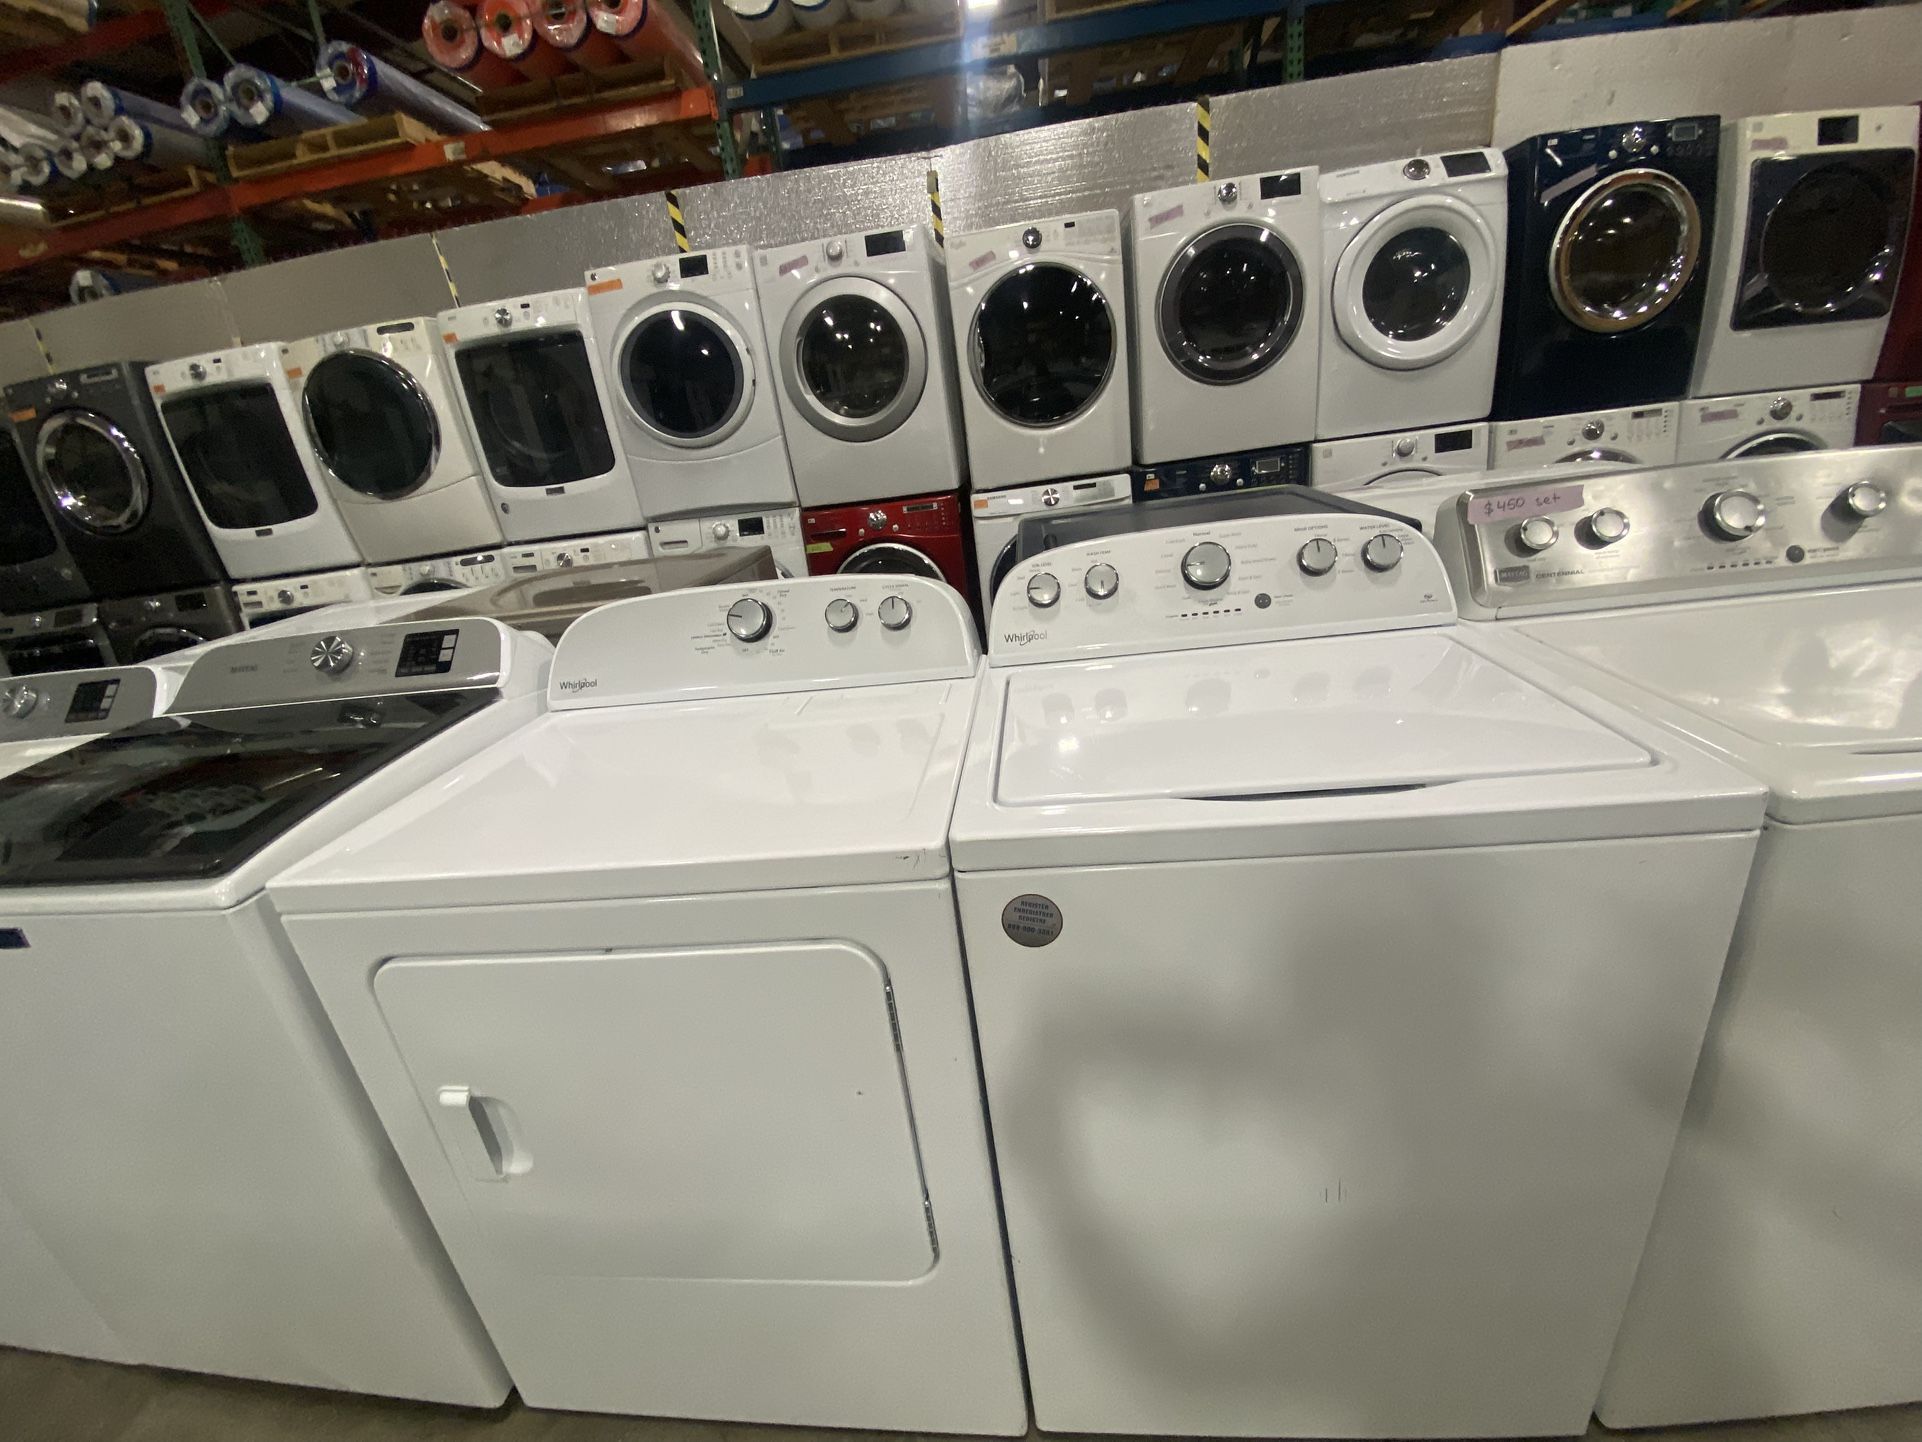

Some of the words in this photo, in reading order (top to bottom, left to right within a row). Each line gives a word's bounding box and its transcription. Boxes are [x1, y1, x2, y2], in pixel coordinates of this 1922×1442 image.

[1484, 497, 1525, 517] $450
[1536, 493, 1561, 507] set
[1004, 630, 1047, 646] Whirlpool
[560, 678, 597, 693] Whirlpool
